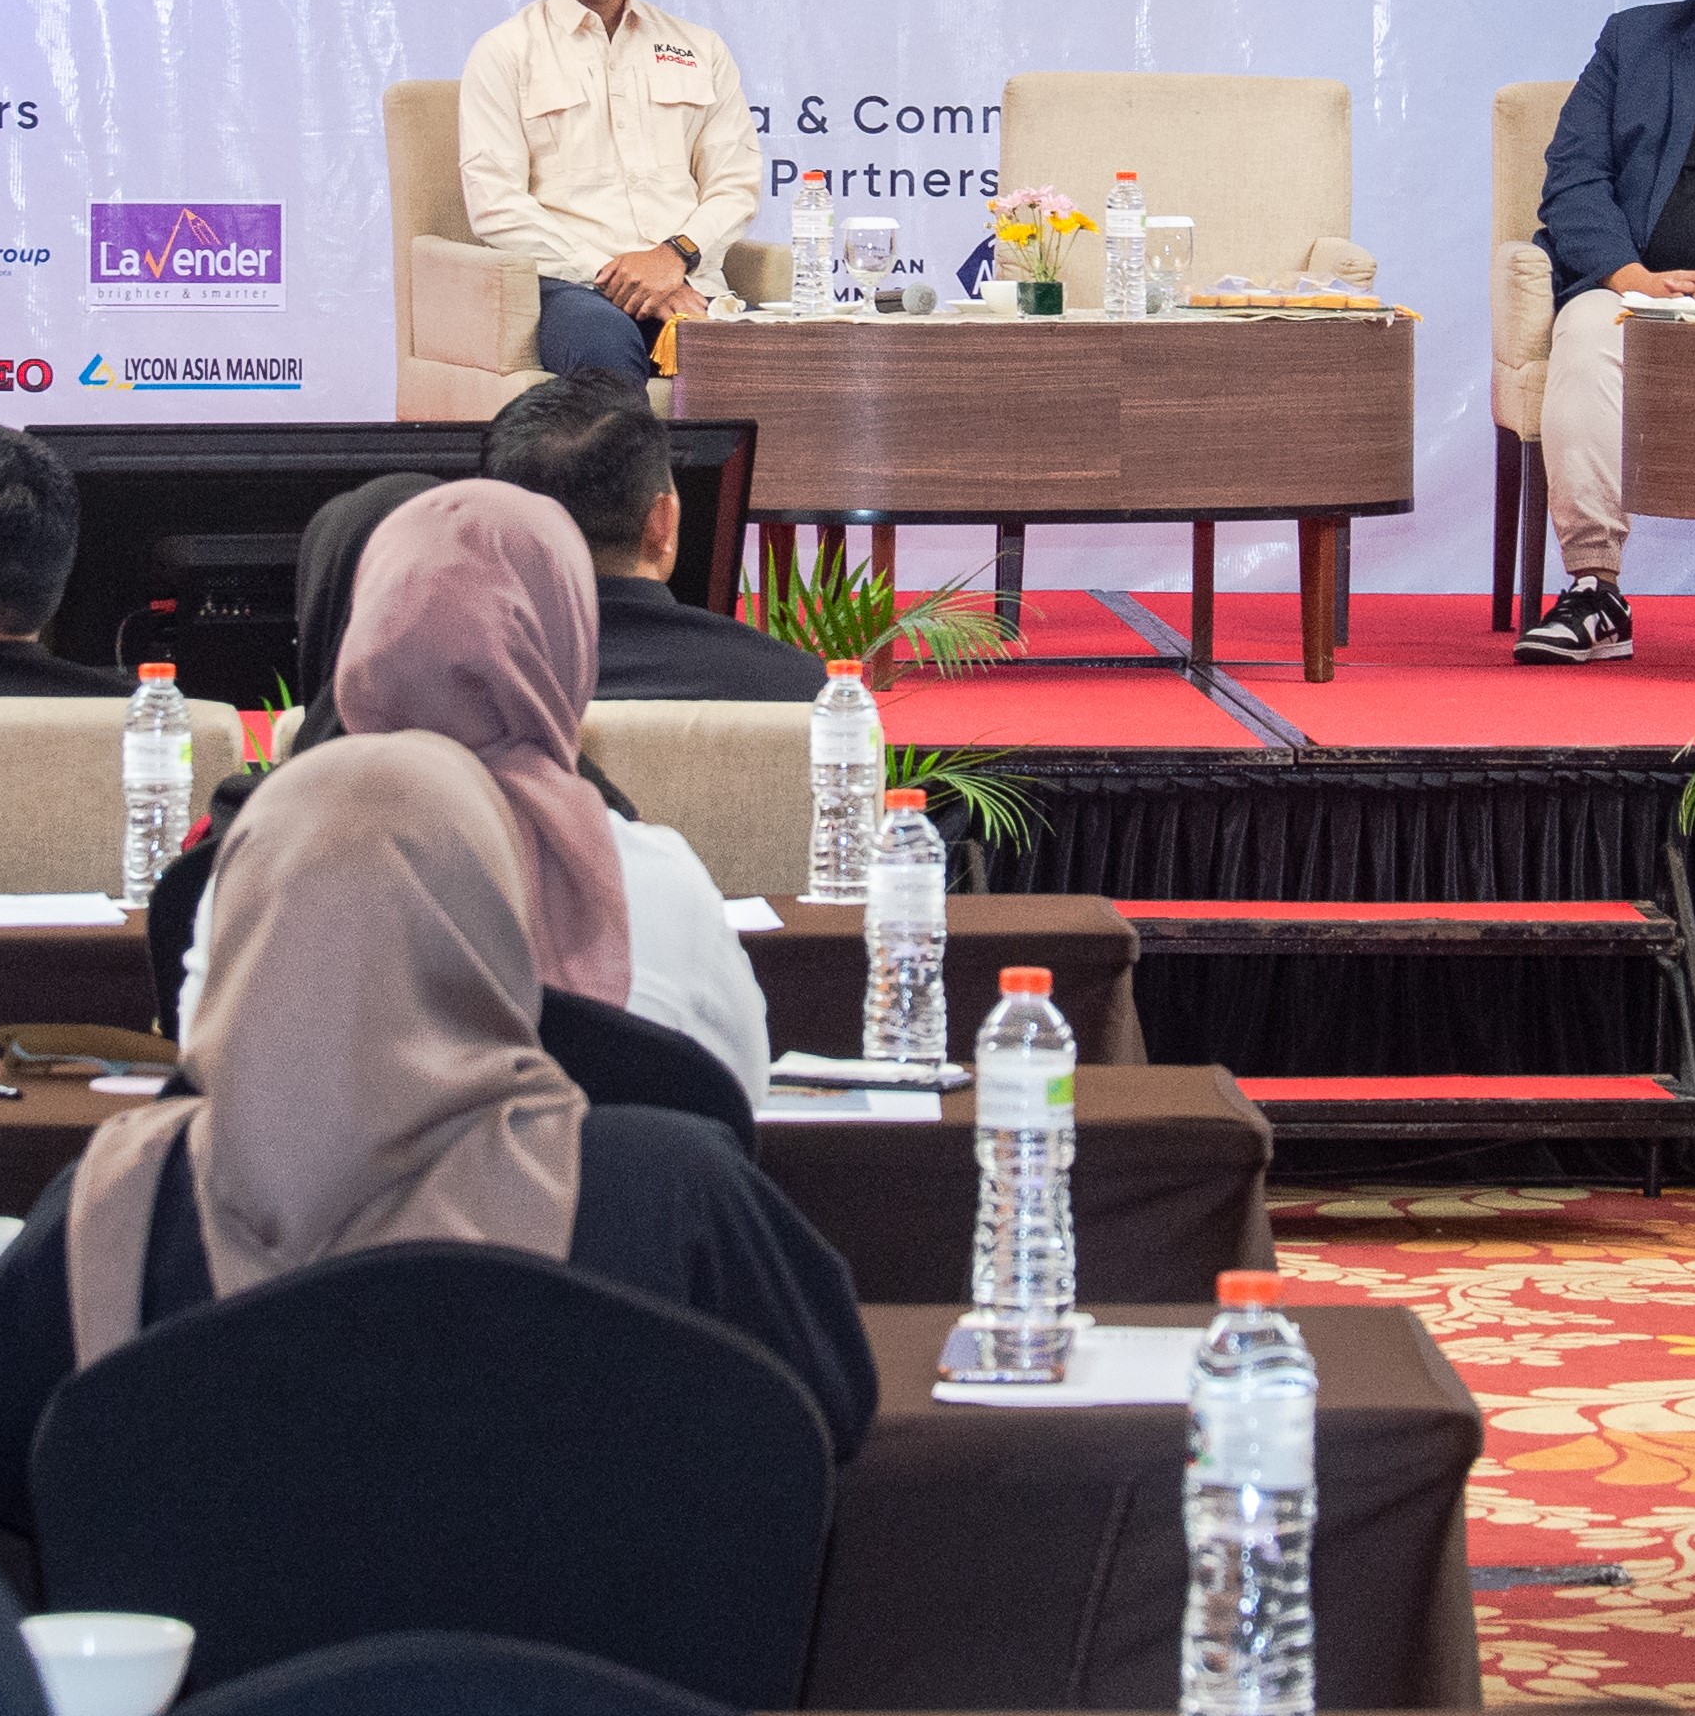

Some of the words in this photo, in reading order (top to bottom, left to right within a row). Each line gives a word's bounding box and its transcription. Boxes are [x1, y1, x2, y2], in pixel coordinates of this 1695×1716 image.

[796, 95, 829, 135] &
[97, 287, 170, 302] brighter
[182, 288, 191, 299] &
[202, 289, 268, 299] smarter
[124, 358, 178, 381] LYCON
[182, 358, 222, 381] ASIA
[226, 358, 303, 381] MANDIRI
